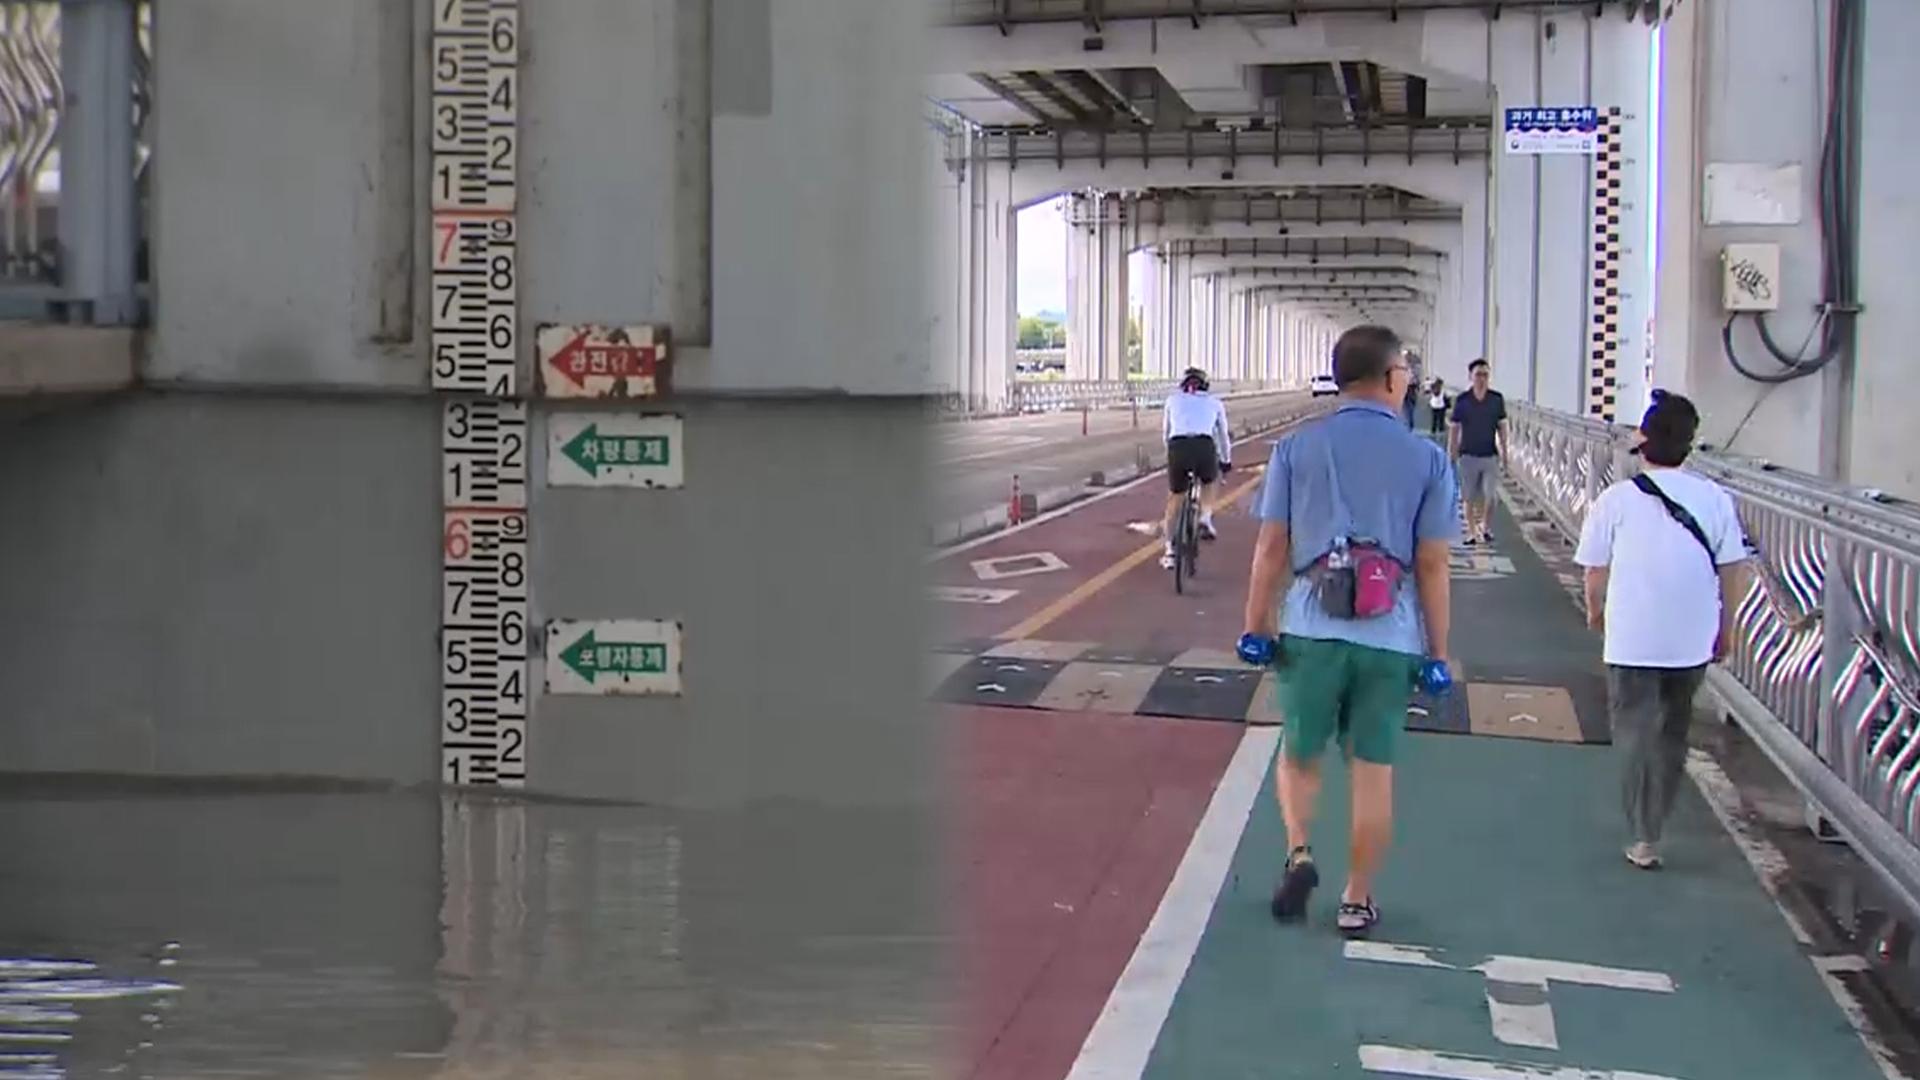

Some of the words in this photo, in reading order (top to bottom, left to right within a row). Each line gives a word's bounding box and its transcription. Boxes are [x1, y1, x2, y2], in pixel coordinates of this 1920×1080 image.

[492, 18, 514, 52] 6
[437, 47, 458, 81] 5
[491, 76, 512, 112] 4
[437, 105, 458, 140] 3
[491, 136, 512, 170] 2
[438, 165, 450, 199] 1
[435, 222, 457, 263] 7
[491, 219, 513, 239] 9
[490, 255, 512, 290] 8
[437, 285, 458, 318] 7
[490, 314, 512, 349] 6
[436, 344, 456, 378] 5
[448, 403, 469, 438] 3
[501, 433, 522, 468] 2
[449, 463, 460, 497] 1
[448, 519, 469, 559] 6
[502, 515, 523, 536] 9
[501, 552, 524, 587] 8
[448, 582, 469, 614] 7
[501, 611, 523, 645] 6
[447, 640, 467, 674] 5
[500, 669, 523, 704] 4
[447, 697, 467, 732] 3
[501, 728, 522, 763] 2
[448, 757, 459, 784] 1
